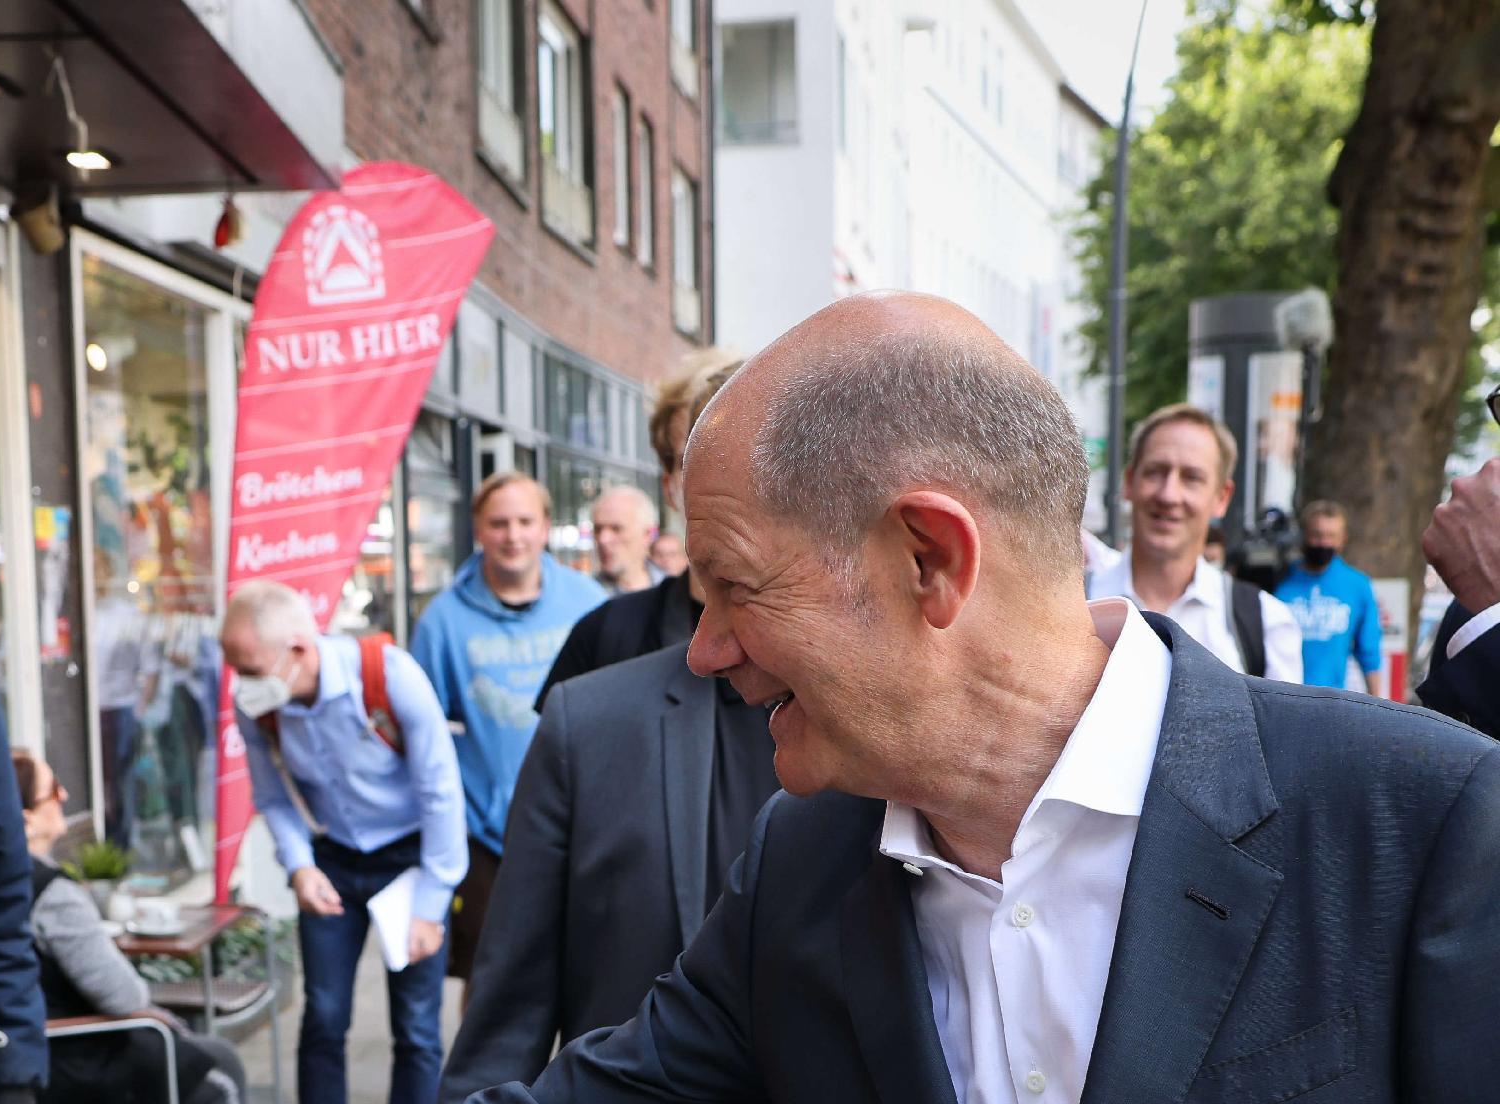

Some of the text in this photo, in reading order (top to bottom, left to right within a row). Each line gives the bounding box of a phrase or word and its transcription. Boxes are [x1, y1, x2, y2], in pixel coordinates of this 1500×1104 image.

[258, 313, 442, 374] NUR HIER
[236, 465, 363, 508] Brötchen
[236, 530, 338, 571] Kuchen
